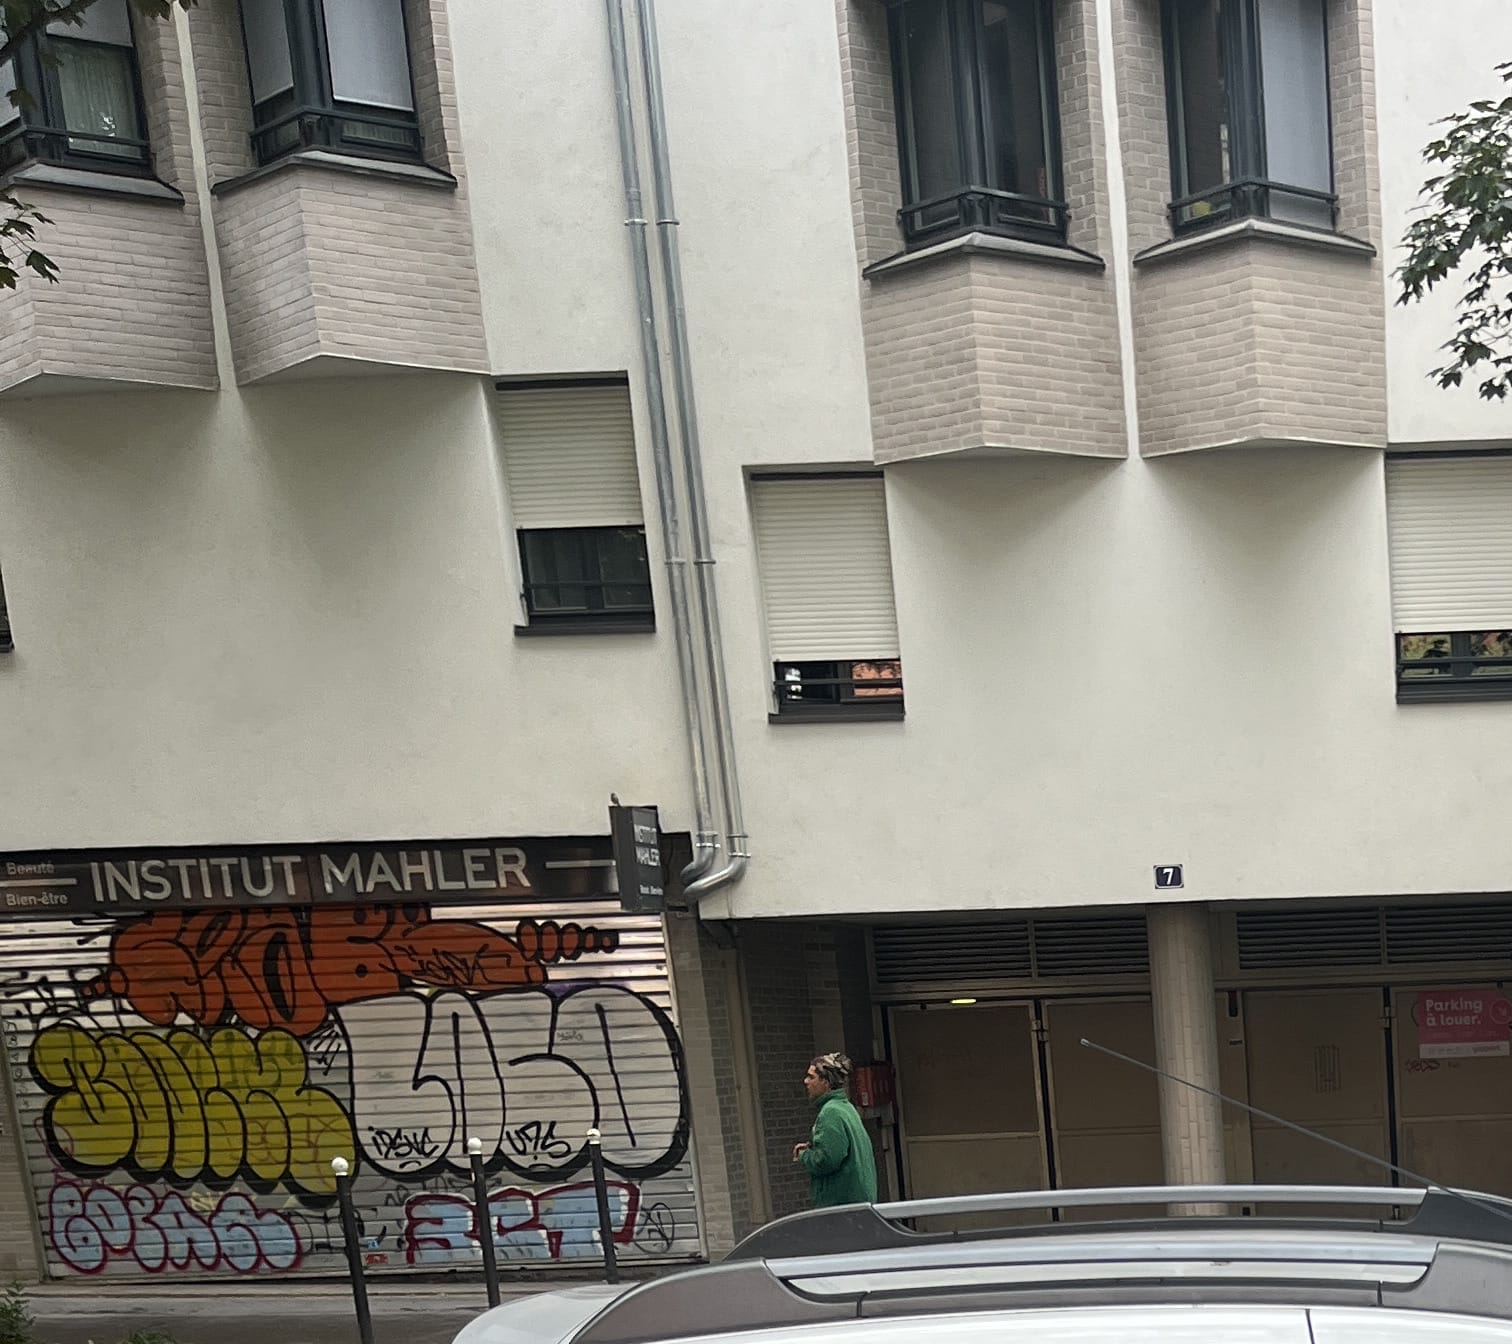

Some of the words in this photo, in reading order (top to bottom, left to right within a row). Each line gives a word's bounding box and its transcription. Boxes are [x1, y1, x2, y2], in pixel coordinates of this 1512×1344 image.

[90, 855, 302, 902] INSTITUT
[319, 847, 531, 894] MAHLER
[1162, 867, 1174, 885] 7
[6, 892, 69, 907] Bien-être
[1425, 997, 1483, 1014] Parking
[1426, 1012, 1437, 1026] à
[1440, 1013, 1482, 1026] louer.
